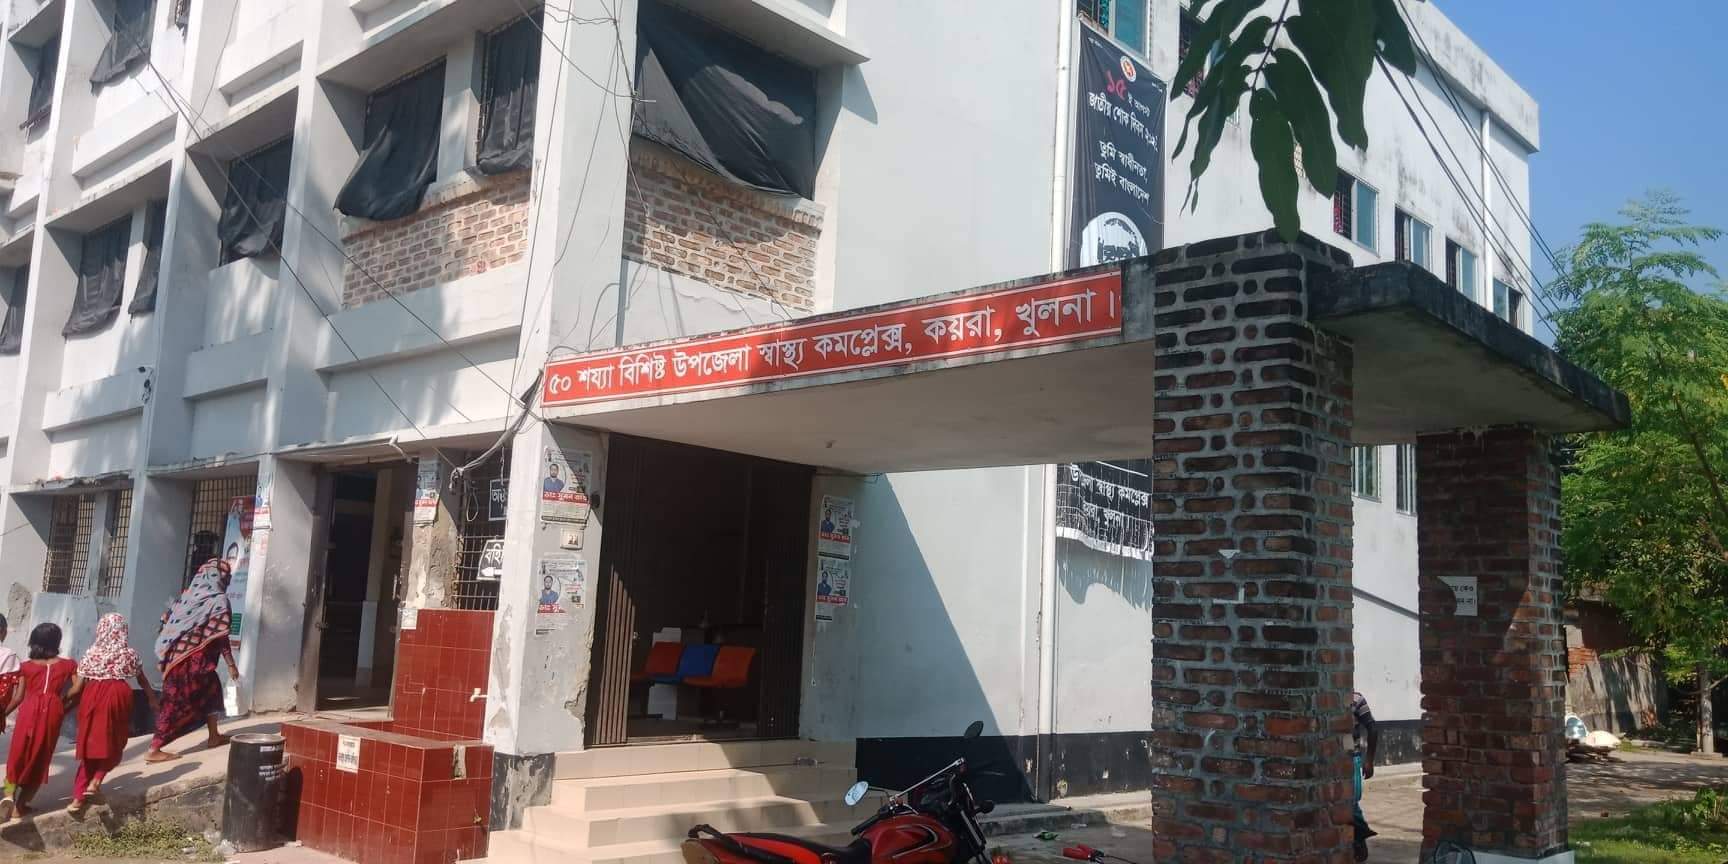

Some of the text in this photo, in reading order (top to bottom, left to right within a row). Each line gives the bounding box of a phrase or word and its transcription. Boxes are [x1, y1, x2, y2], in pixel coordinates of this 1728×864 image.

[1105, 69, 1126, 101] ১৫
[1088, 92, 1112, 118] জাতীয়
[1113, 106, 1130, 126] শোক
[1099, 140, 1116, 160] তুমি
[1094, 162, 1151, 206] তুমিই বাংলাদেশ
[549, 374, 572, 395] ৫০
[577, 365, 614, 391] শয্যা
[619, 354, 667, 386] বিশিষ্ট
[672, 345, 752, 377] উপজেলা
[757, 337, 808, 371] স্বাস্থ্য
[812, 323, 912, 361] কমপ্লেক্স,
[921, 304, 1003, 343] কয়রা,
